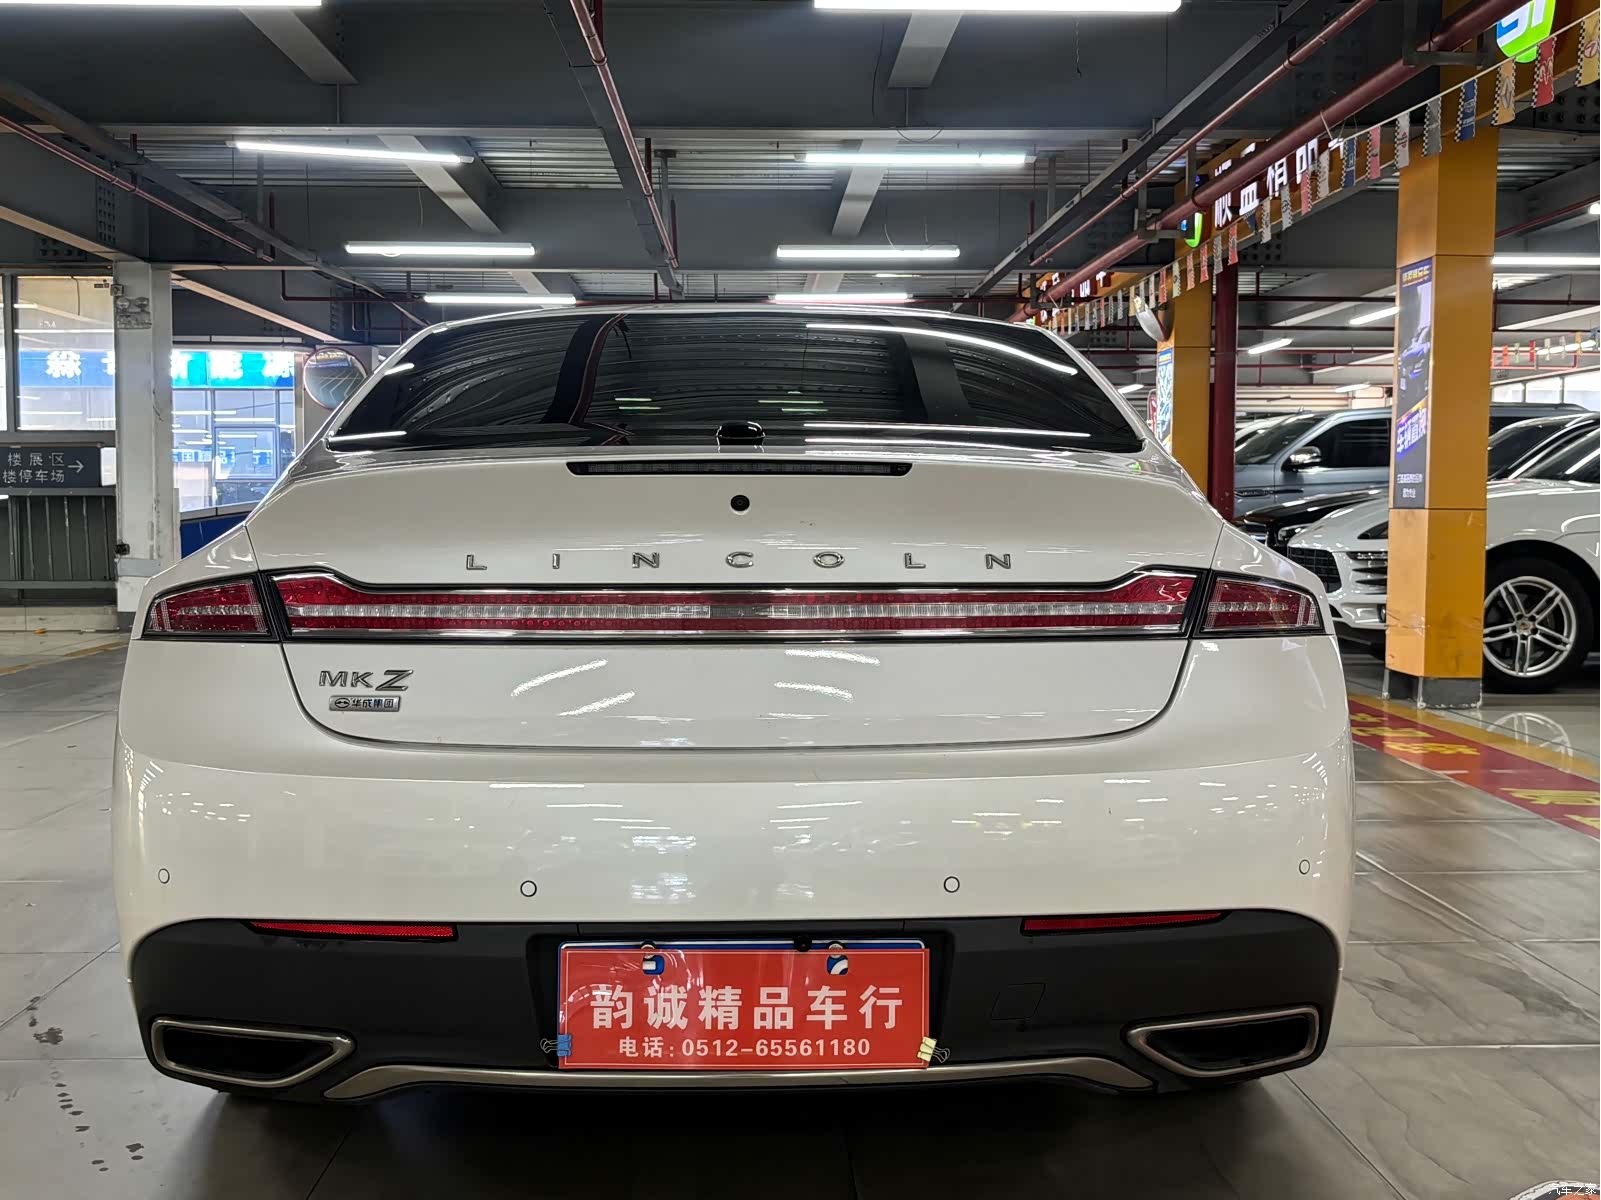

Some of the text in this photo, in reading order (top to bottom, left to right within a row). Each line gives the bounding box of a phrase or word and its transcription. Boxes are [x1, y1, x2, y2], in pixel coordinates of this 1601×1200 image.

[466, 551, 1012, 571] LINCOLN
[318, 668, 414, 691] MKZ
[350, 697, 394, 709] 华成集团
[590, 983, 903, 1030] 韵诚精品车行
